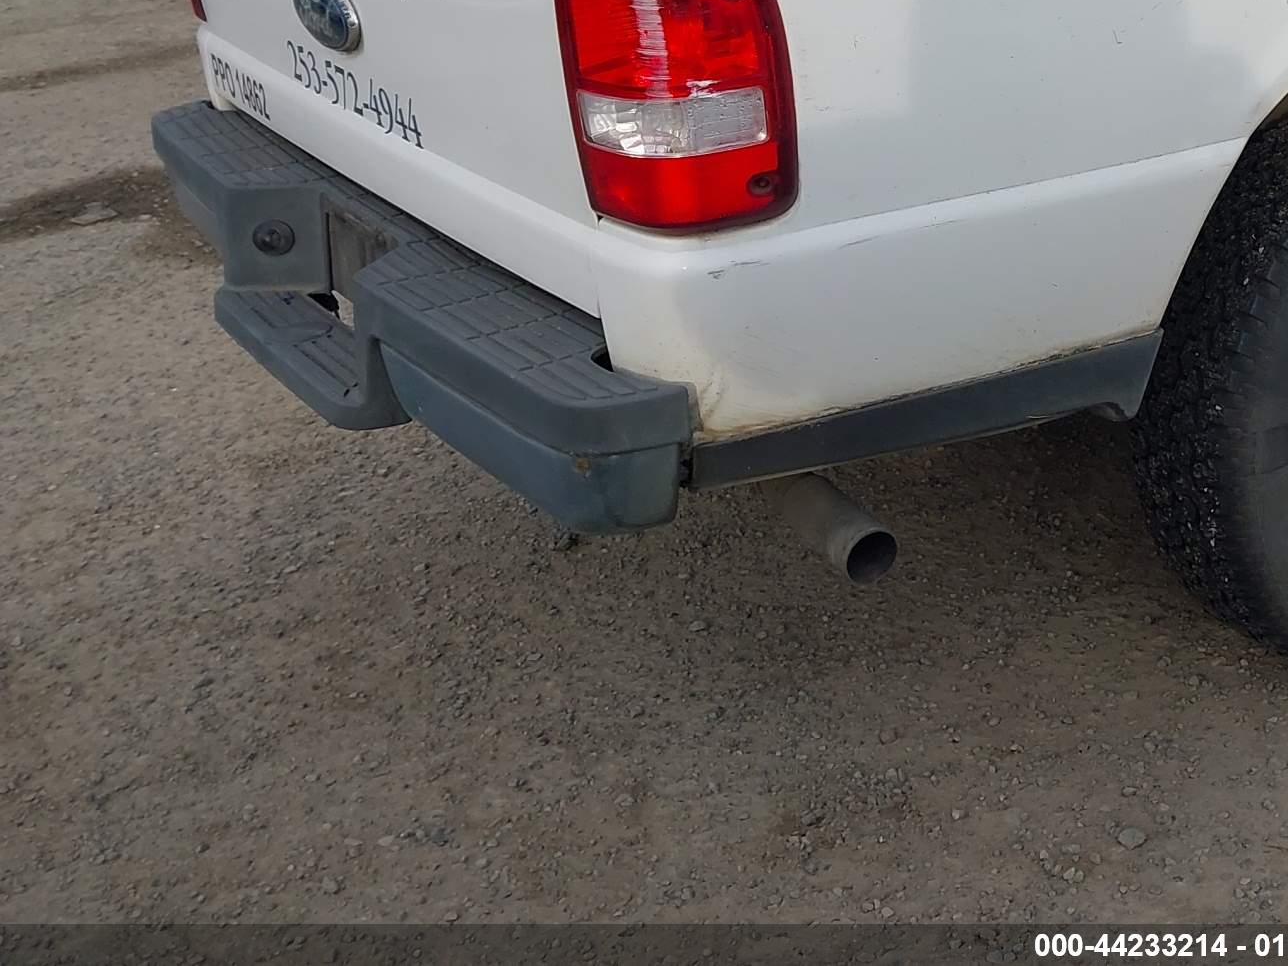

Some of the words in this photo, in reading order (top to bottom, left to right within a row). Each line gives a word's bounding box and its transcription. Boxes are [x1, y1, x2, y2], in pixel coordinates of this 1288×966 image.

[210, 53, 236, 98] PPO
[234, 68, 271, 122] 14862
[286, 40, 424, 150] 253-572-4944
